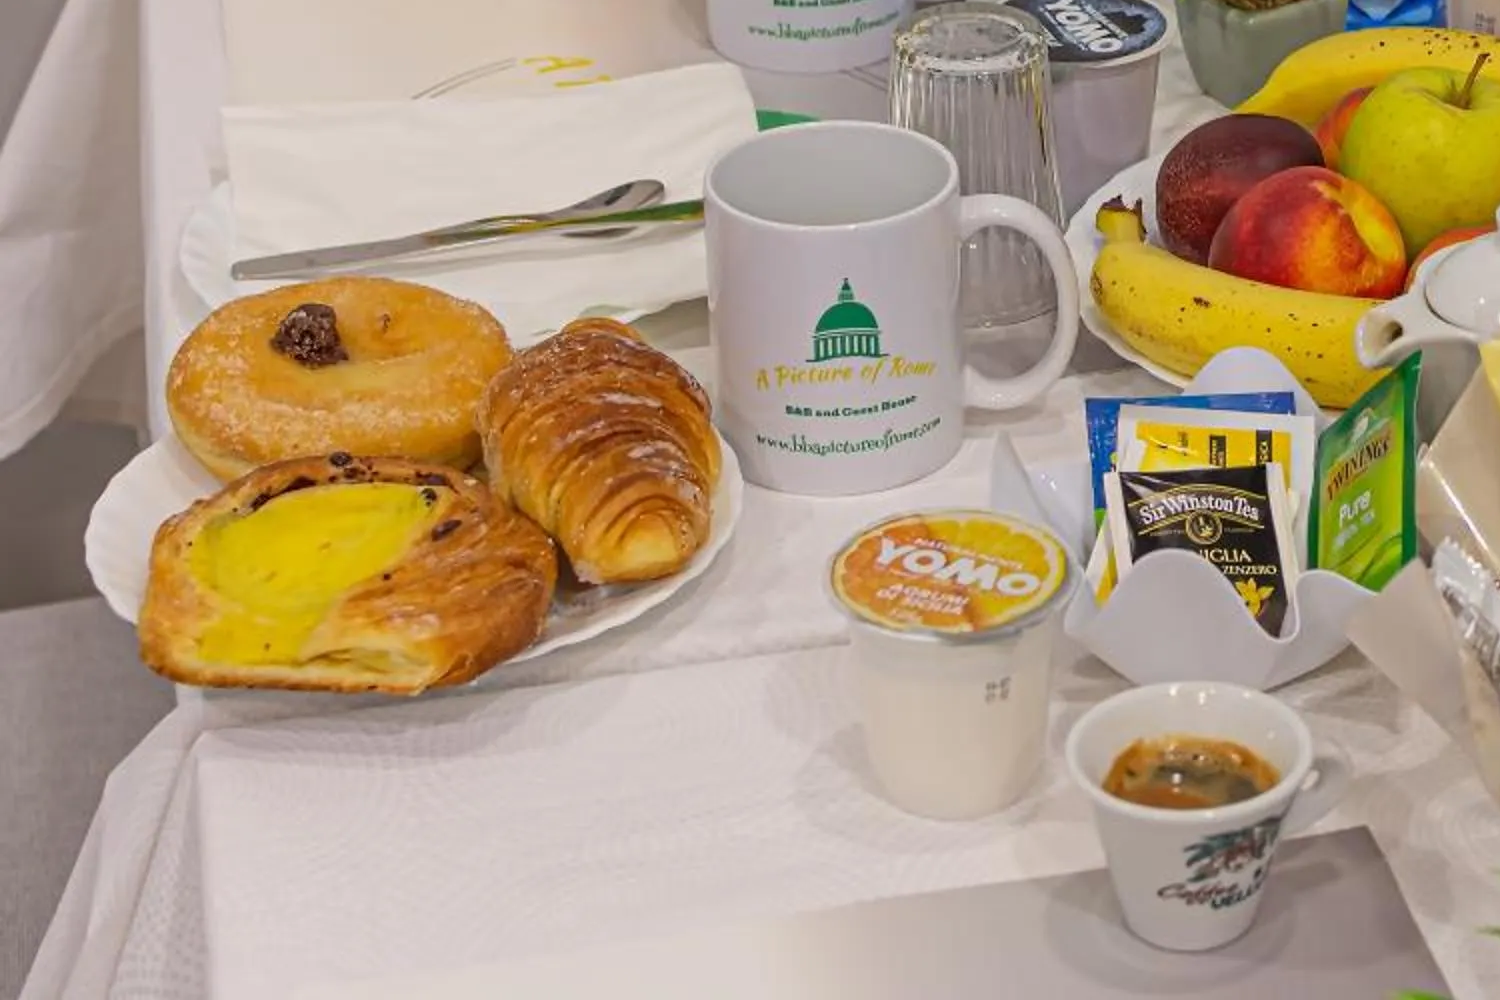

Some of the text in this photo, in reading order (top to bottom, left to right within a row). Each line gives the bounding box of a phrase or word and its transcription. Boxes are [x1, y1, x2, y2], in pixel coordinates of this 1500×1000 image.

[756, 367, 771, 392] A
[773, 364, 853, 389] Picture
[859, 357, 885, 385] of
[785, 394, 919, 417] B&B and Guest House
[1138, 493, 1260, 526] Sir Winston Tea
[876, 535, 1041, 597] YOMO
[1200, 548, 1253, 564] IGLIA
